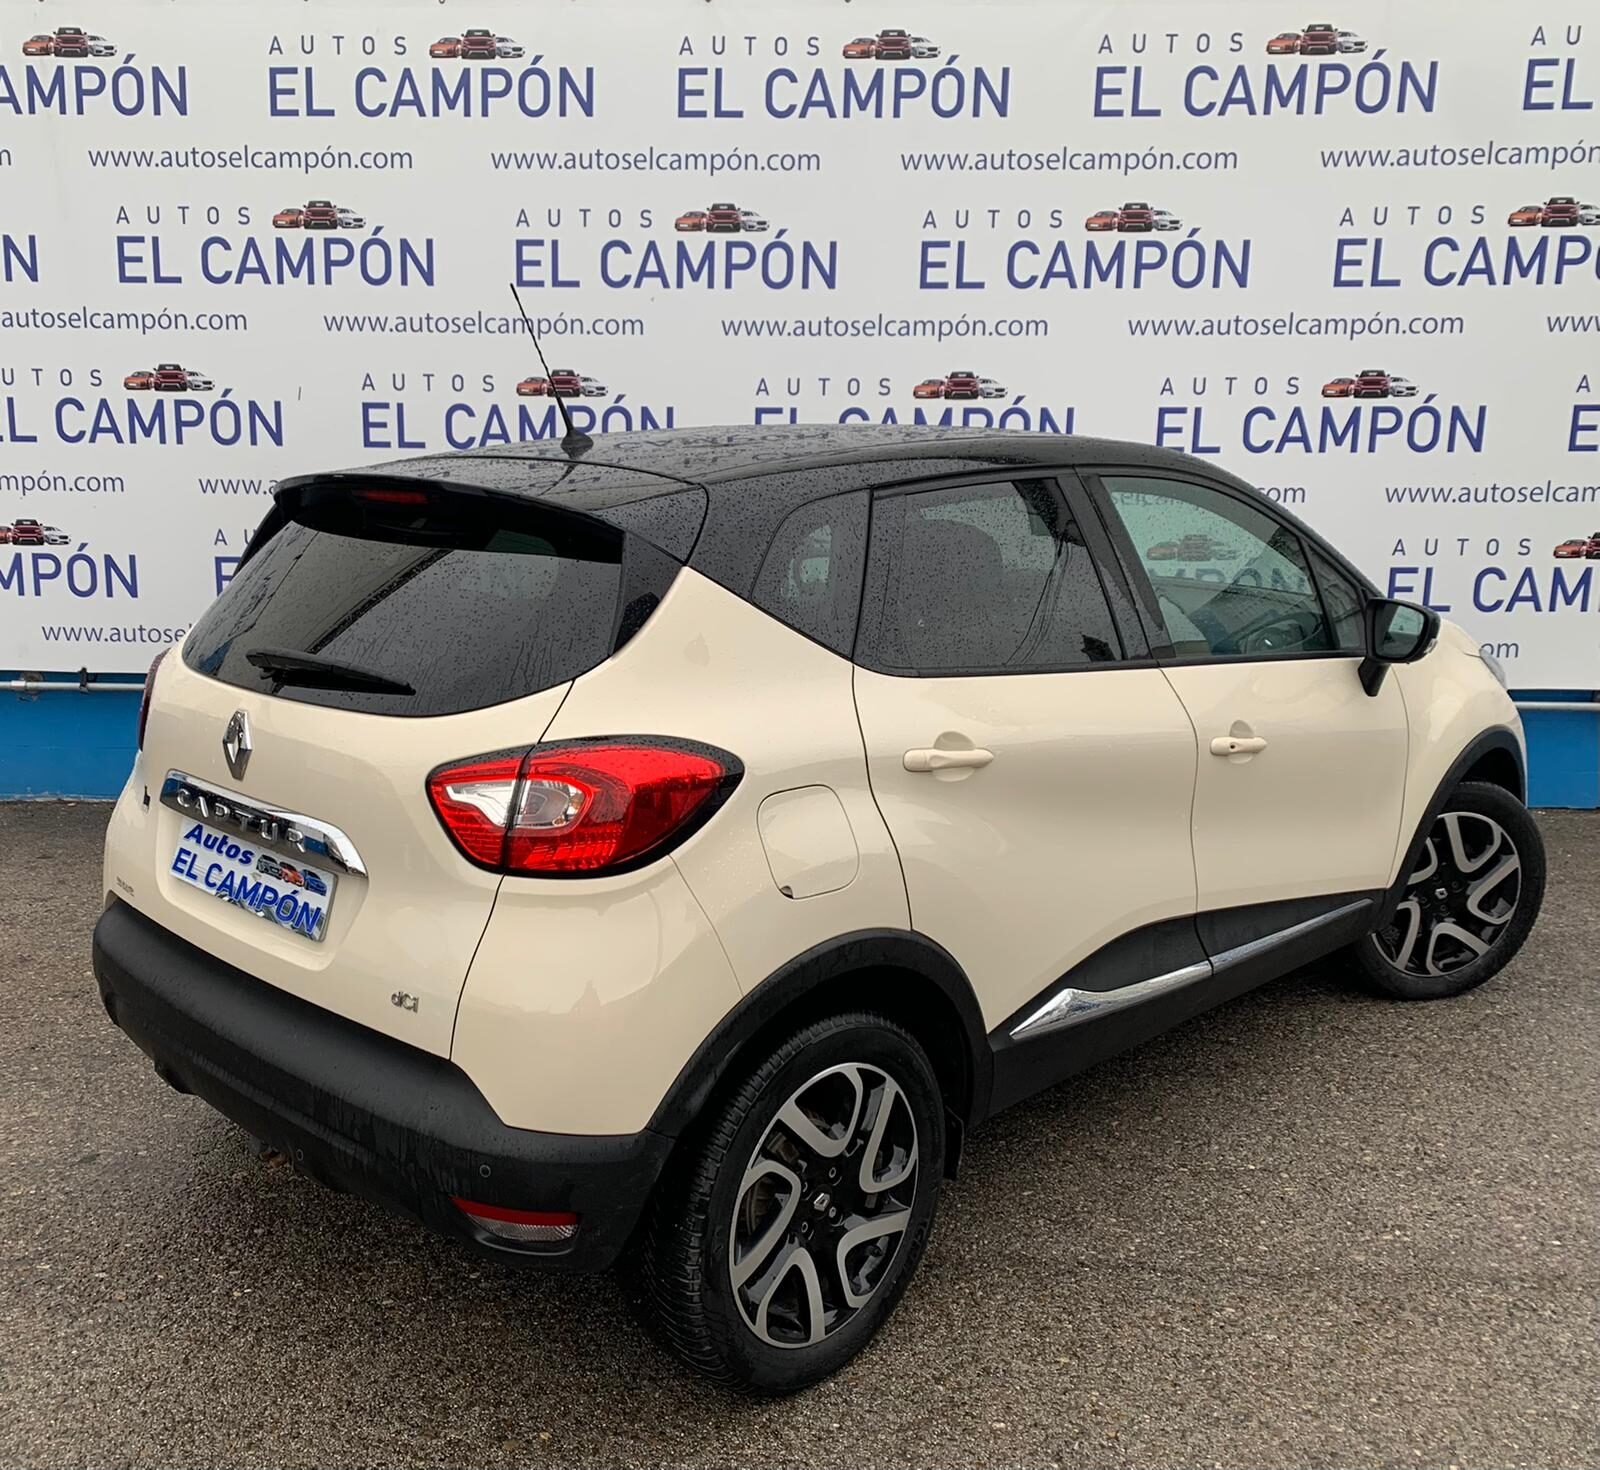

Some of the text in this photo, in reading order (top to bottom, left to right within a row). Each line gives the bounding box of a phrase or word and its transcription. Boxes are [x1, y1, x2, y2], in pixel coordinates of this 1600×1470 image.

[268, 34, 407, 56] AUTOS
[678, 35, 820, 57] AUTOS
[1097, 32, 1243, 55] AUTOS
[268, 54, 595, 118] EL CAMPÓN
[677, 54, 1010, 119] EL CAMPÓN
[1093, 48, 1439, 118] EL CAMPÓN
[1522, 57, 1594, 111] EL
[87, 144, 413, 175] www.autoselcampón.com
[490, 145, 821, 177] www.autoselcampón.com
[900, 145, 1238, 177] www.autoselcampón.com
[115, 205, 251, 226] AUTOS
[515, 208, 653, 229] AUTOS
[922, 209, 1063, 229] AUTOS
[1338, 204, 1485, 227] AUTOS
[116, 226, 435, 286] EL CAMPÓN
[515, 229, 838, 290] EL CAMPÓN
[919, 228, 1252, 290] EL CAMPÓN
[1332, 234, 1600, 288] EL CAMP
[323, 310, 645, 341] www.autoselcampón.com
[721, 312, 1049, 343] www.autoselcampón.com
[1128, 311, 1464, 341] www.autoselcampón.com
[361, 372, 495, 393] AUTOS
[755, 377, 891, 397] AUTOS
[1159, 376, 1300, 396] AUTOS
[54, 388, 284, 447] CAMPÓN
[361, 401, 427, 450] EL
[1155, 393, 1488, 454] EL CAMPÓN
[1391, 537, 1532, 557] AUTOS
[1387, 566, 1600, 613] EL CAM
[184, 822, 255, 865] Autos
[171, 846, 322, 934] EL CAMPÓN
